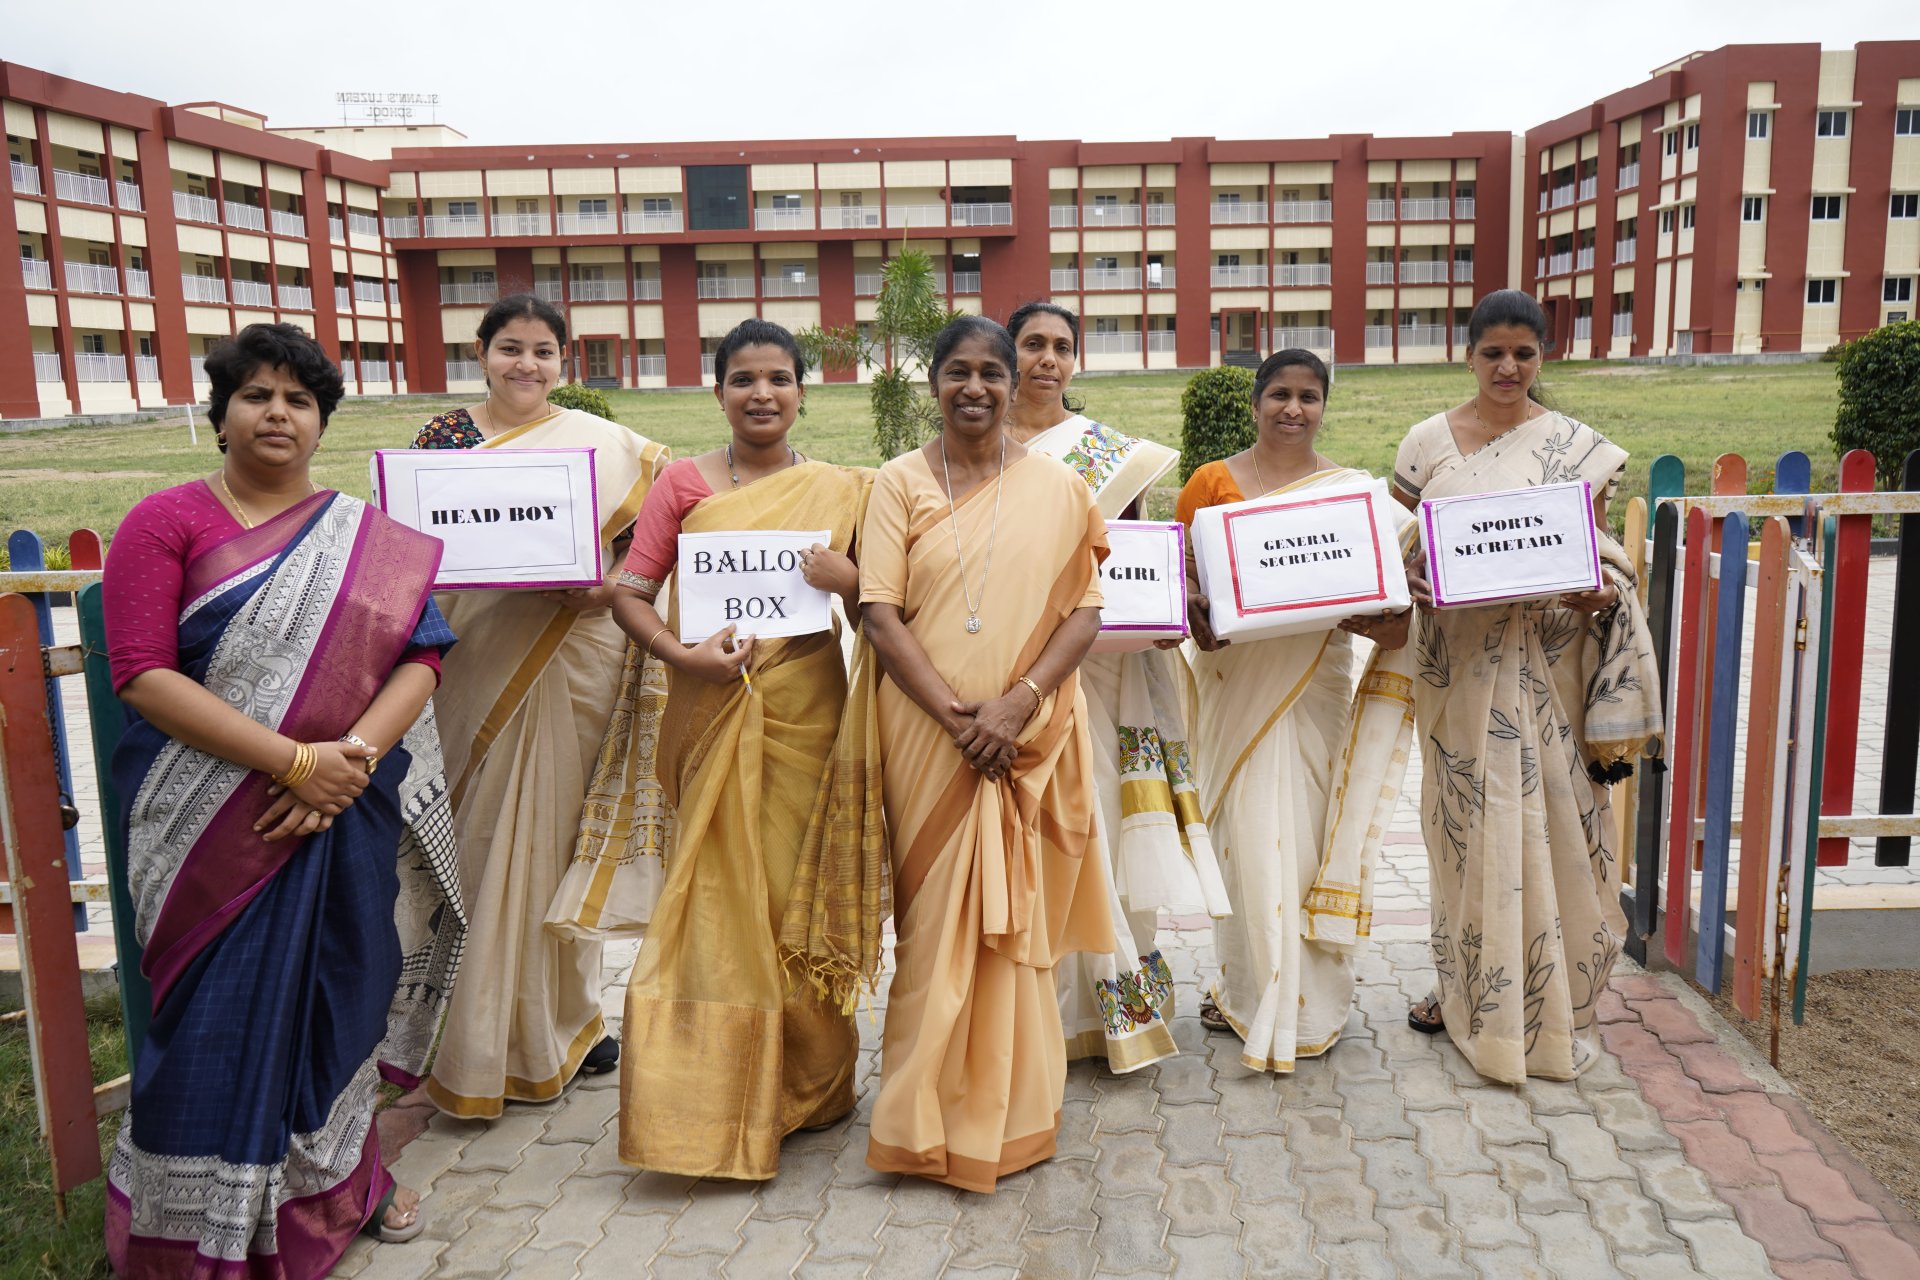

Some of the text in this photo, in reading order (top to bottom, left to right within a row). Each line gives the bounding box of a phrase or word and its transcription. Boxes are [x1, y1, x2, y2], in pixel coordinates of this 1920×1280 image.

[431, 505, 558, 525] HEAD BOY
[1471, 514, 1544, 535] SPORTS
[1263, 532, 1340, 551] GENERAL
[1454, 533, 1565, 557] SECRETARY
[693, 549, 802, 574] BALLO
[1259, 547, 1353, 569] SECRETARY
[1109, 566, 1160, 582] GIRL
[724, 596, 787, 620] BOX
